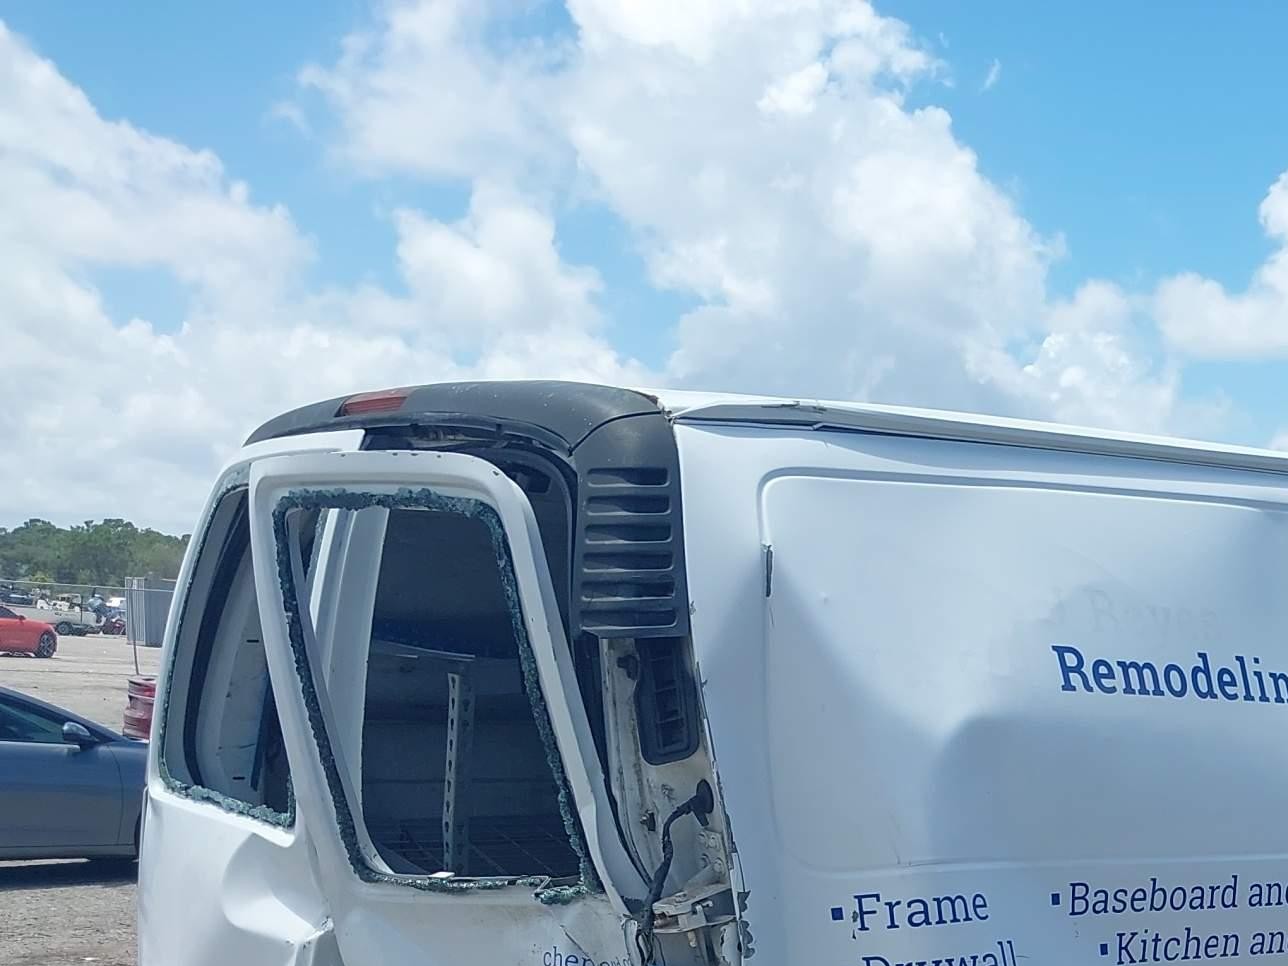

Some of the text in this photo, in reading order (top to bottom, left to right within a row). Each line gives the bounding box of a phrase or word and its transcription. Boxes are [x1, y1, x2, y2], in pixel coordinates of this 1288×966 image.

[853, 893, 989, 931] Frame
[1068, 874, 1238, 916] Baseboard
[1116, 926, 1240, 966] Kitchen
